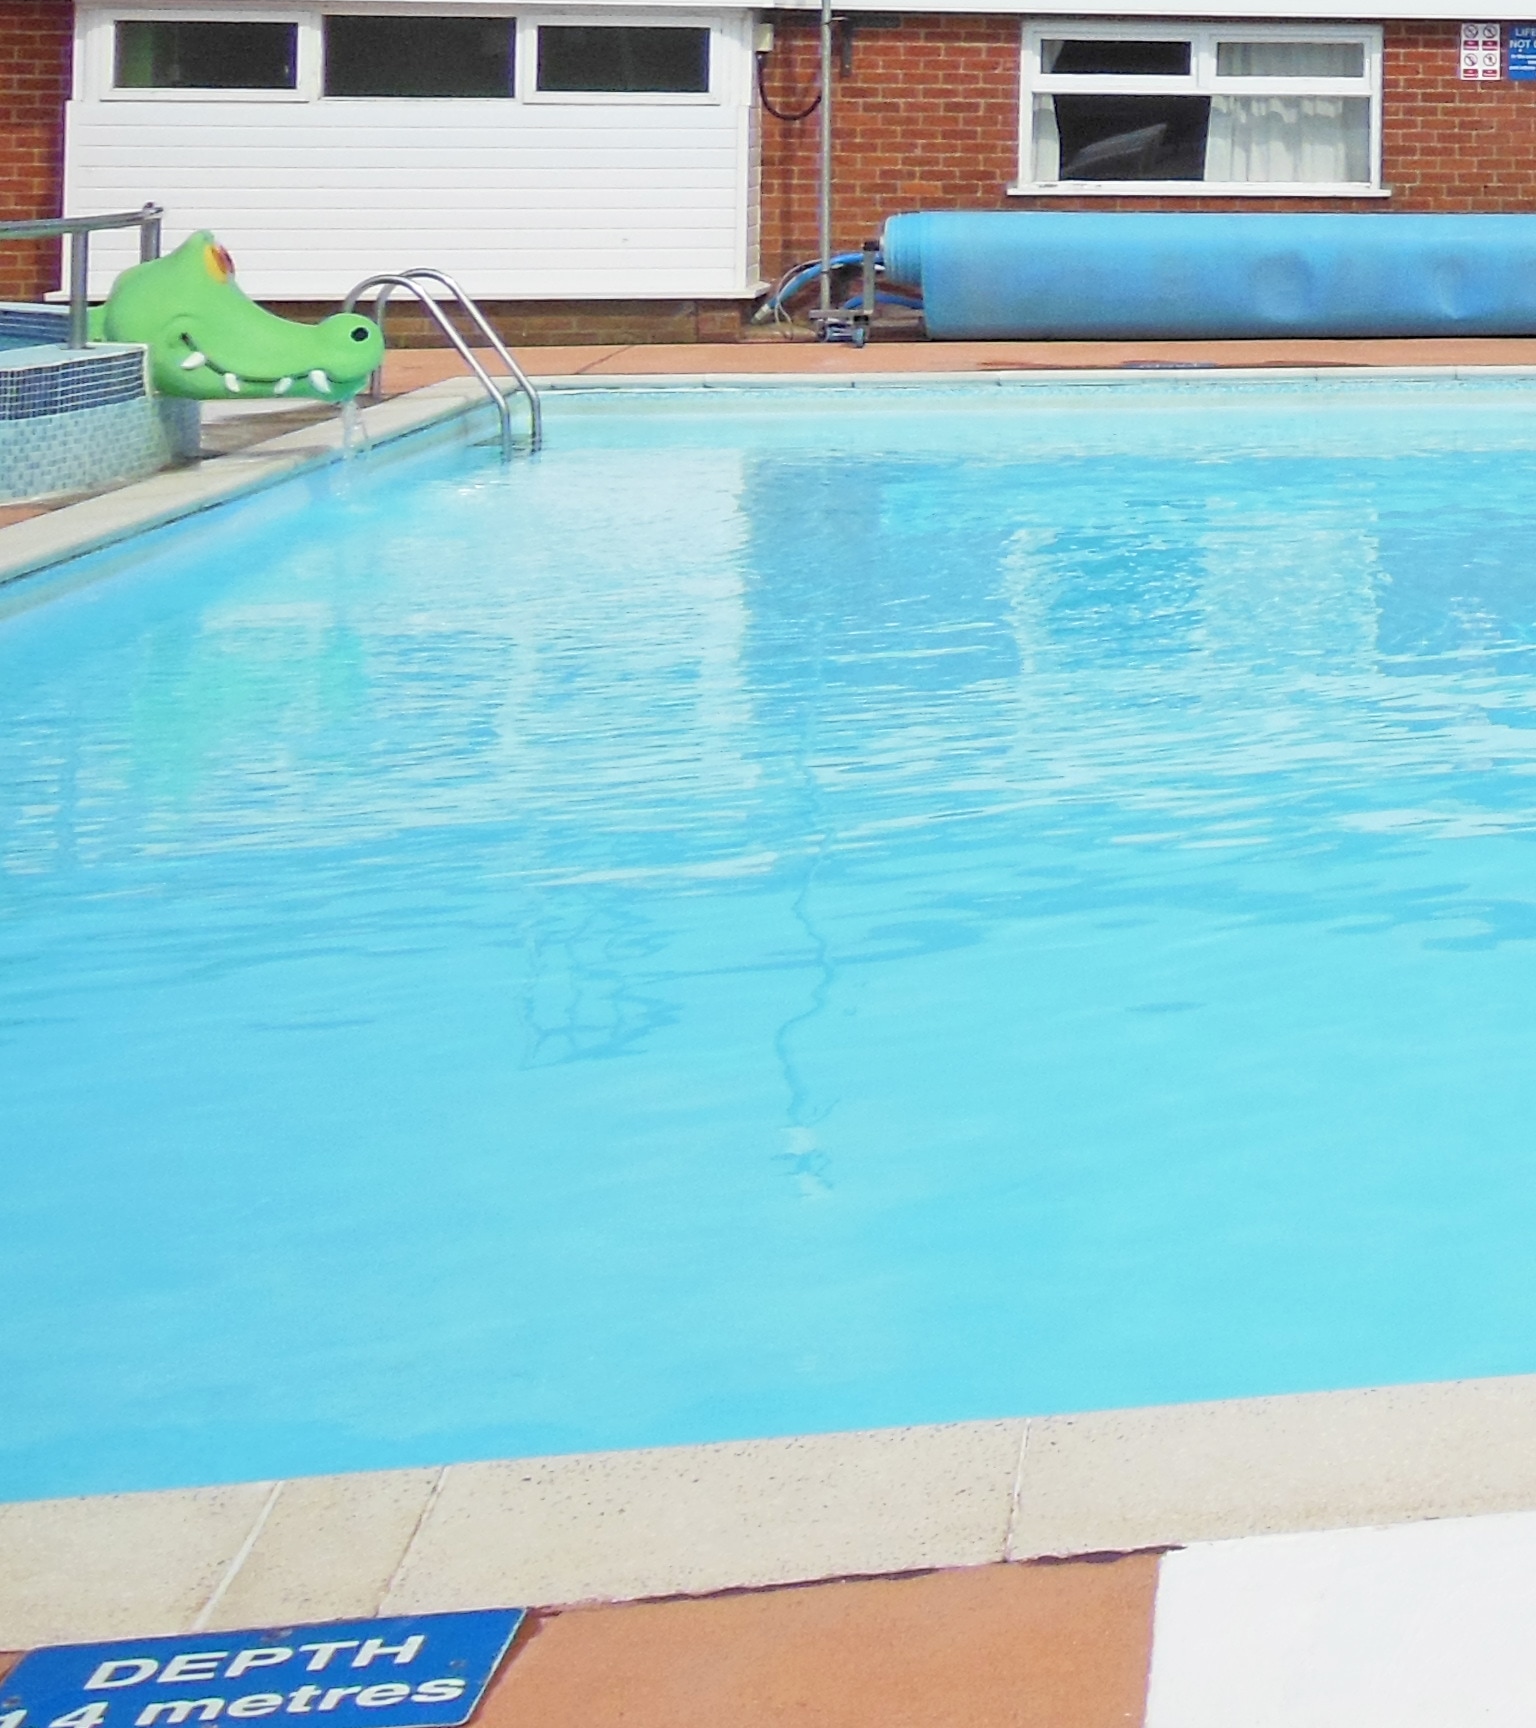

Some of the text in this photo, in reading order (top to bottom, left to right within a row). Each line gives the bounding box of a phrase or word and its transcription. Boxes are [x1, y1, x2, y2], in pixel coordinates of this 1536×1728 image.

[1509, 39, 1531, 49] NOT
[83, 1634, 426, 1690] DEPTH
[134, 1677, 467, 1726] metres
